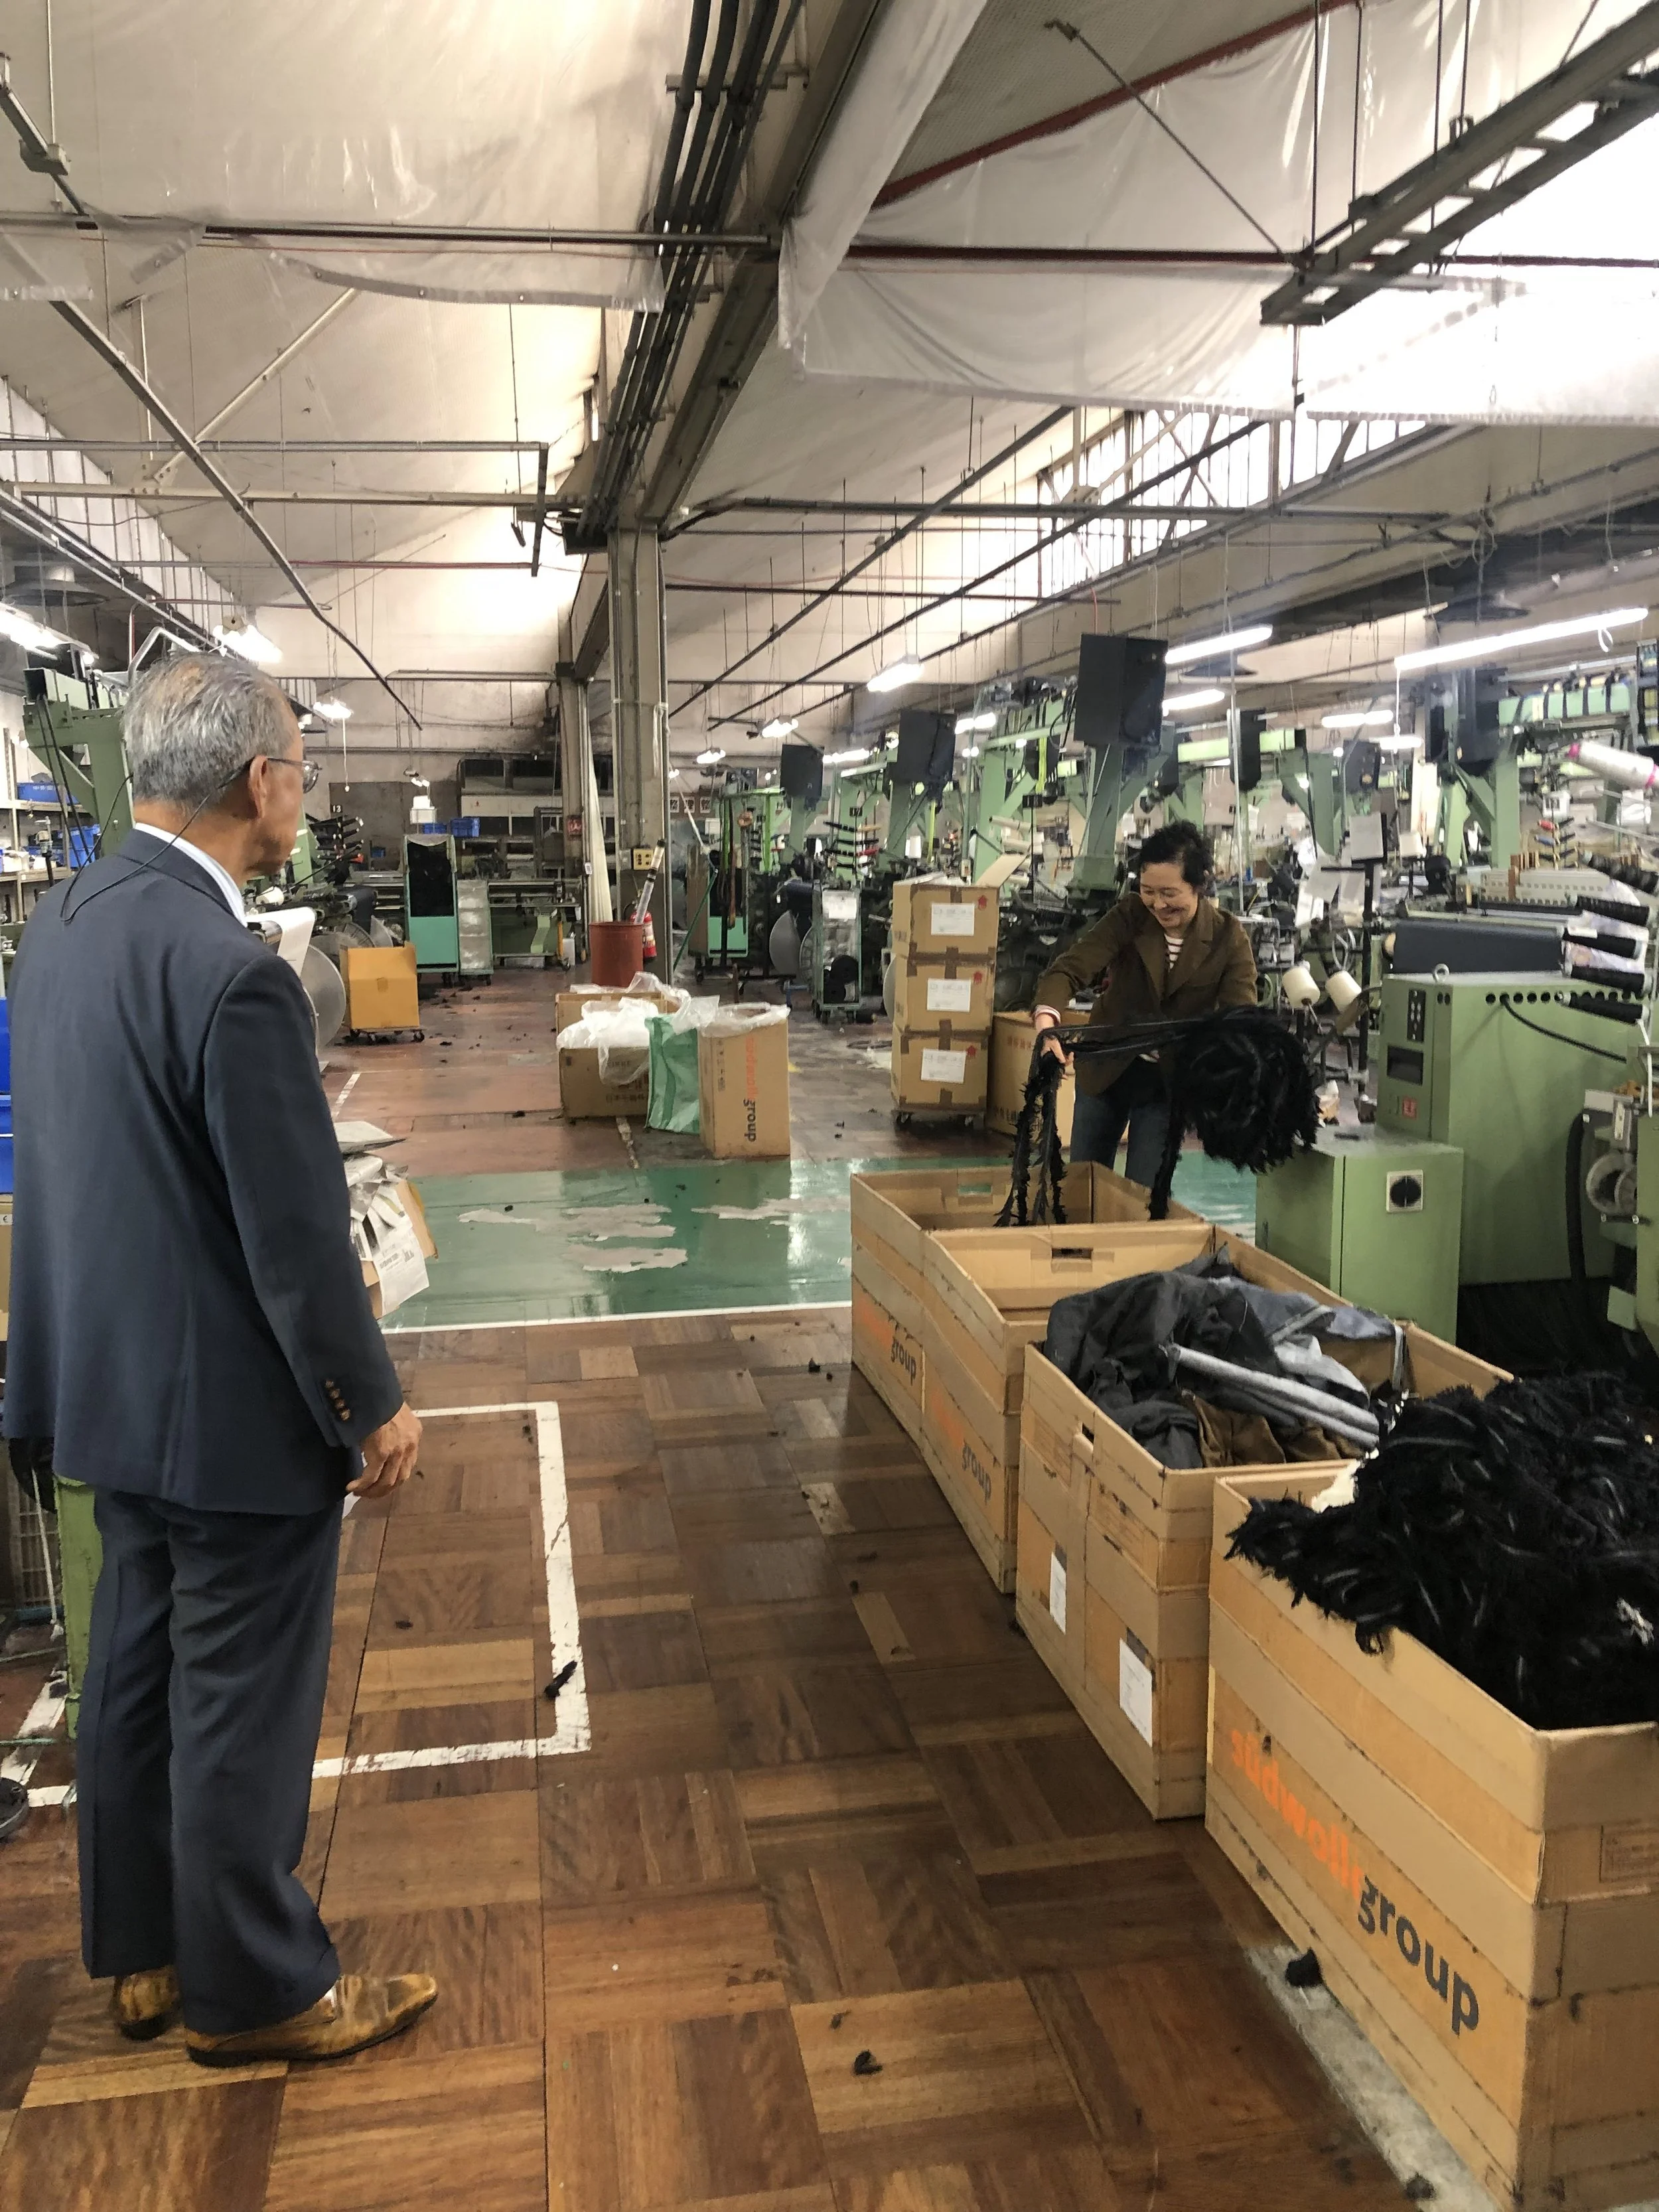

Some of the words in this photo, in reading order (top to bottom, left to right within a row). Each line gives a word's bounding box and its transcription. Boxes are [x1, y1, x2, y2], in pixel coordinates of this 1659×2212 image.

[743, 1098, 757, 1142] group
[891, 1336, 916, 1386] group
[962, 1442, 991, 1505] group
[1358, 1875, 1479, 2037] group
